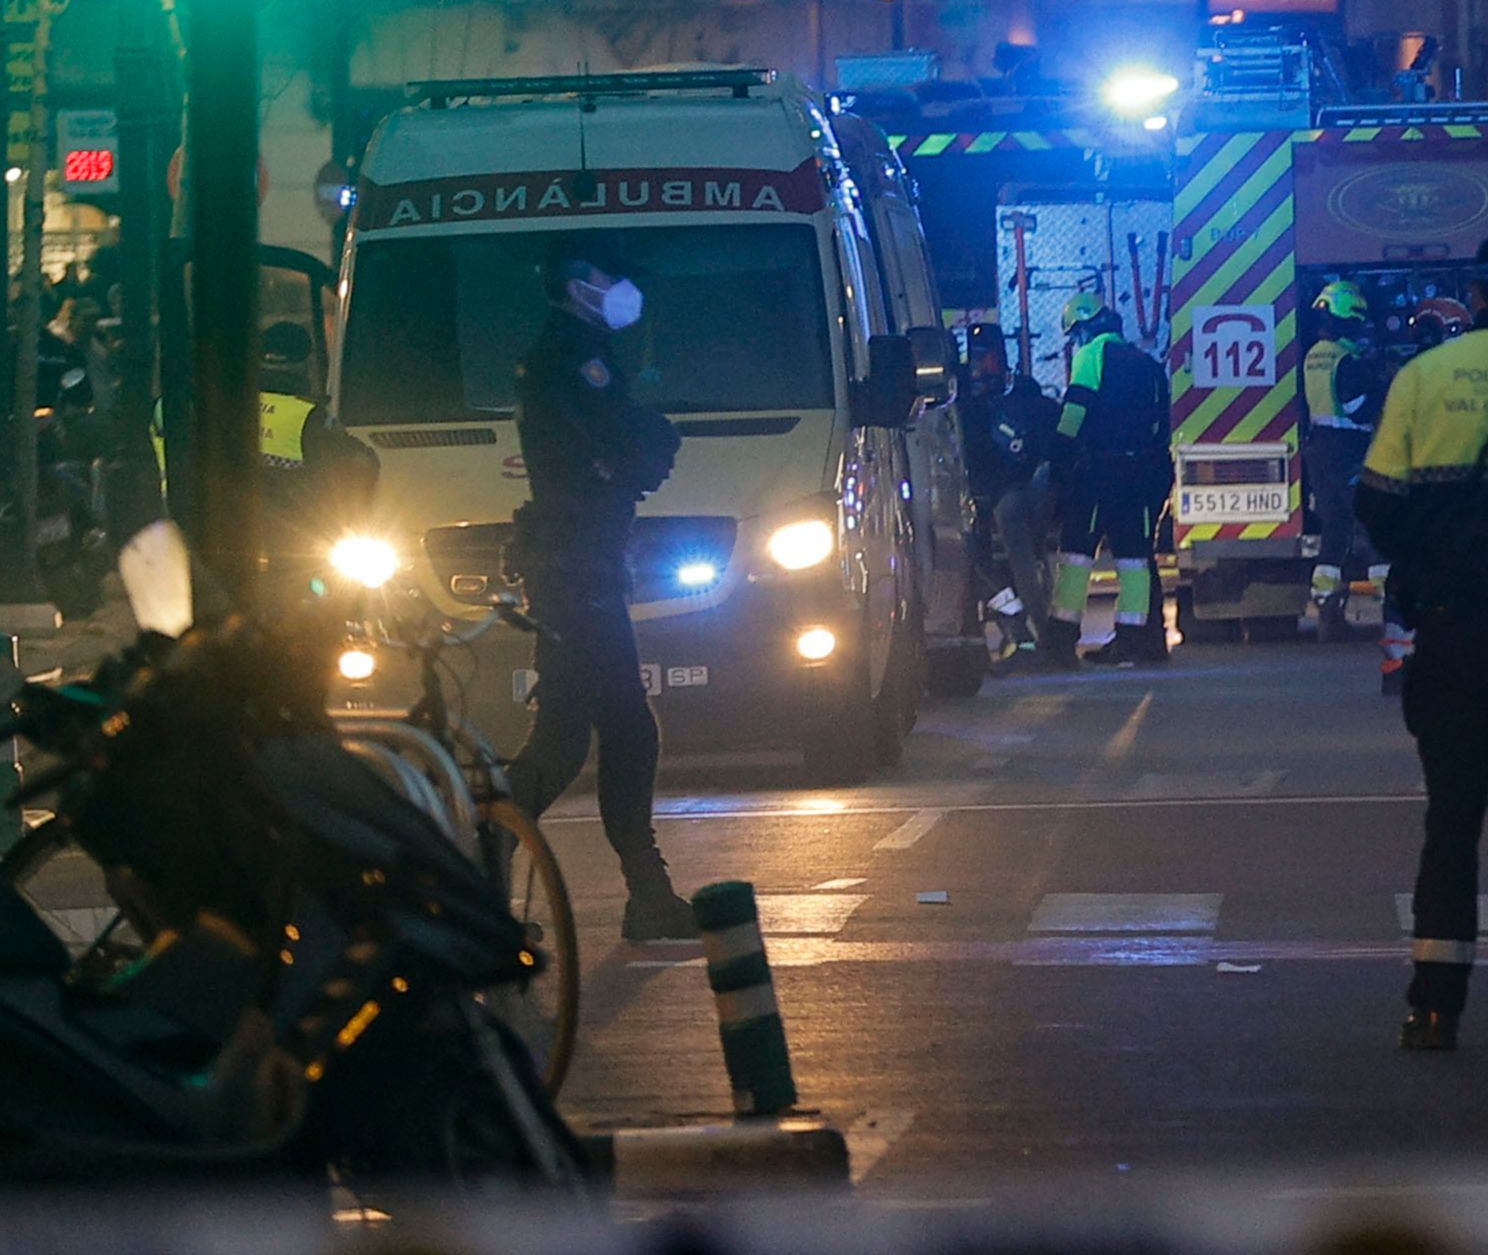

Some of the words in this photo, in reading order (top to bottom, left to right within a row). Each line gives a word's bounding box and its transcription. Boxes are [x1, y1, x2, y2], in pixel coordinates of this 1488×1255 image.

[1203, 340, 1266, 379] 112
[1193, 493, 1241, 512] 5512
[671, 668, 705, 685] SP
